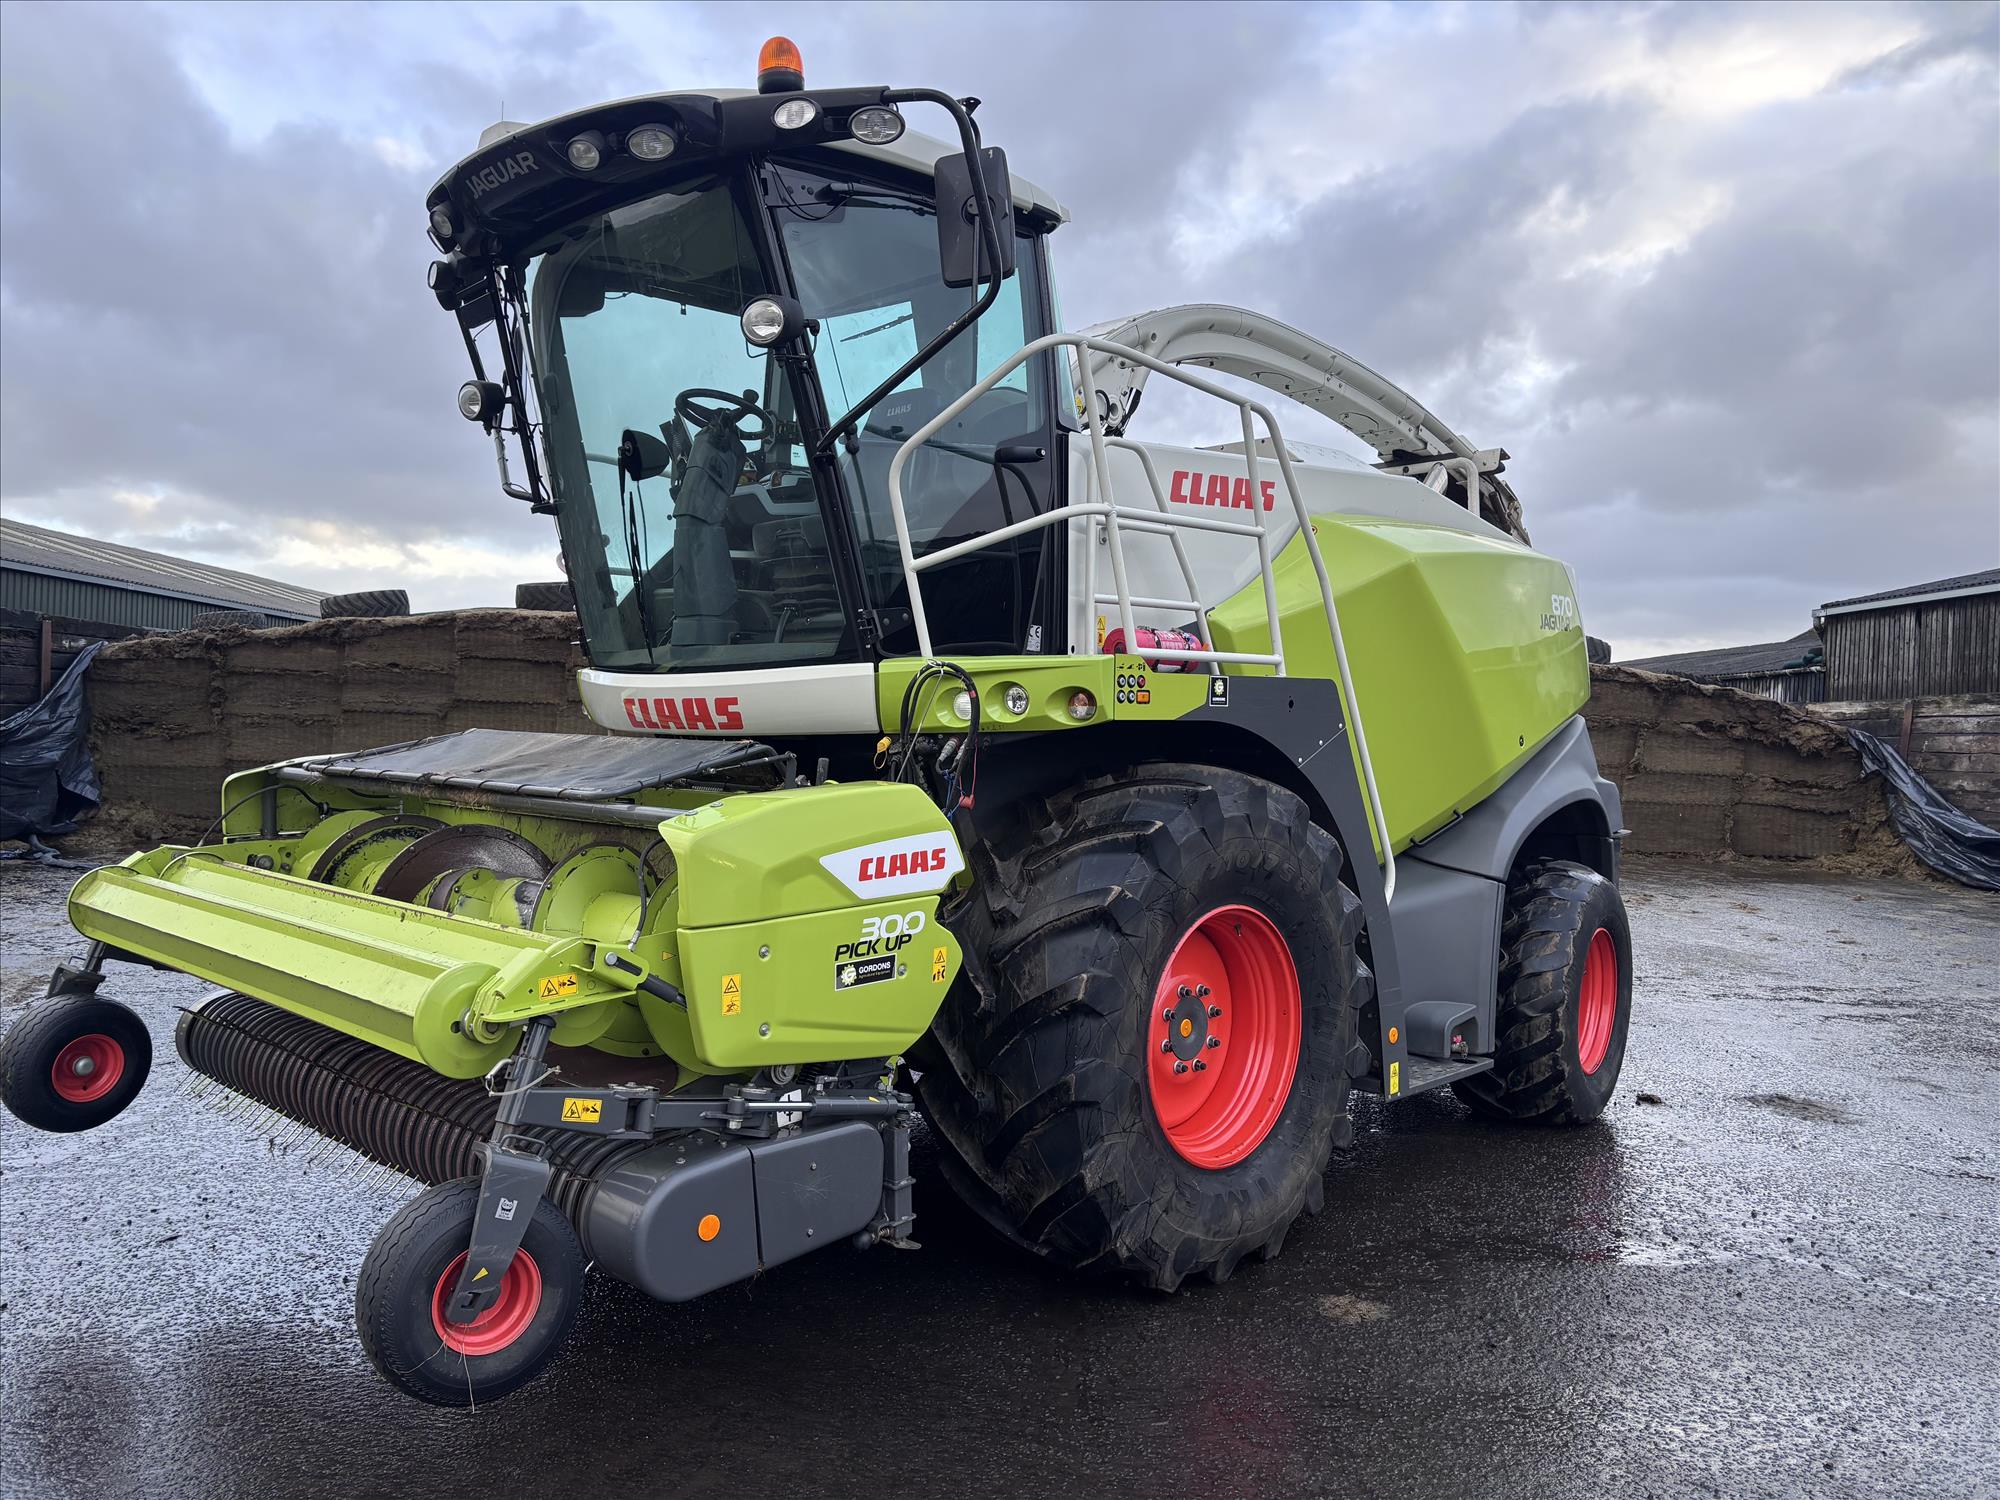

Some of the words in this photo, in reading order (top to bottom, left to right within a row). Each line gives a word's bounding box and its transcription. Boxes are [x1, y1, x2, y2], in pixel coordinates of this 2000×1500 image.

[465, 151, 540, 199] JAGUAR
[887, 403, 912, 417] CLAAS
[1169, 470, 1276, 512] CLAAS
[1551, 594, 1573, 617] 870
[623, 697, 744, 730] CLAAS
[858, 848, 946, 882] CLAAS
[860, 911, 926, 941] 300
[834, 939, 881, 962] PICK
[885, 934, 912, 952] UP
[858, 961, 891, 974] GORDONS
